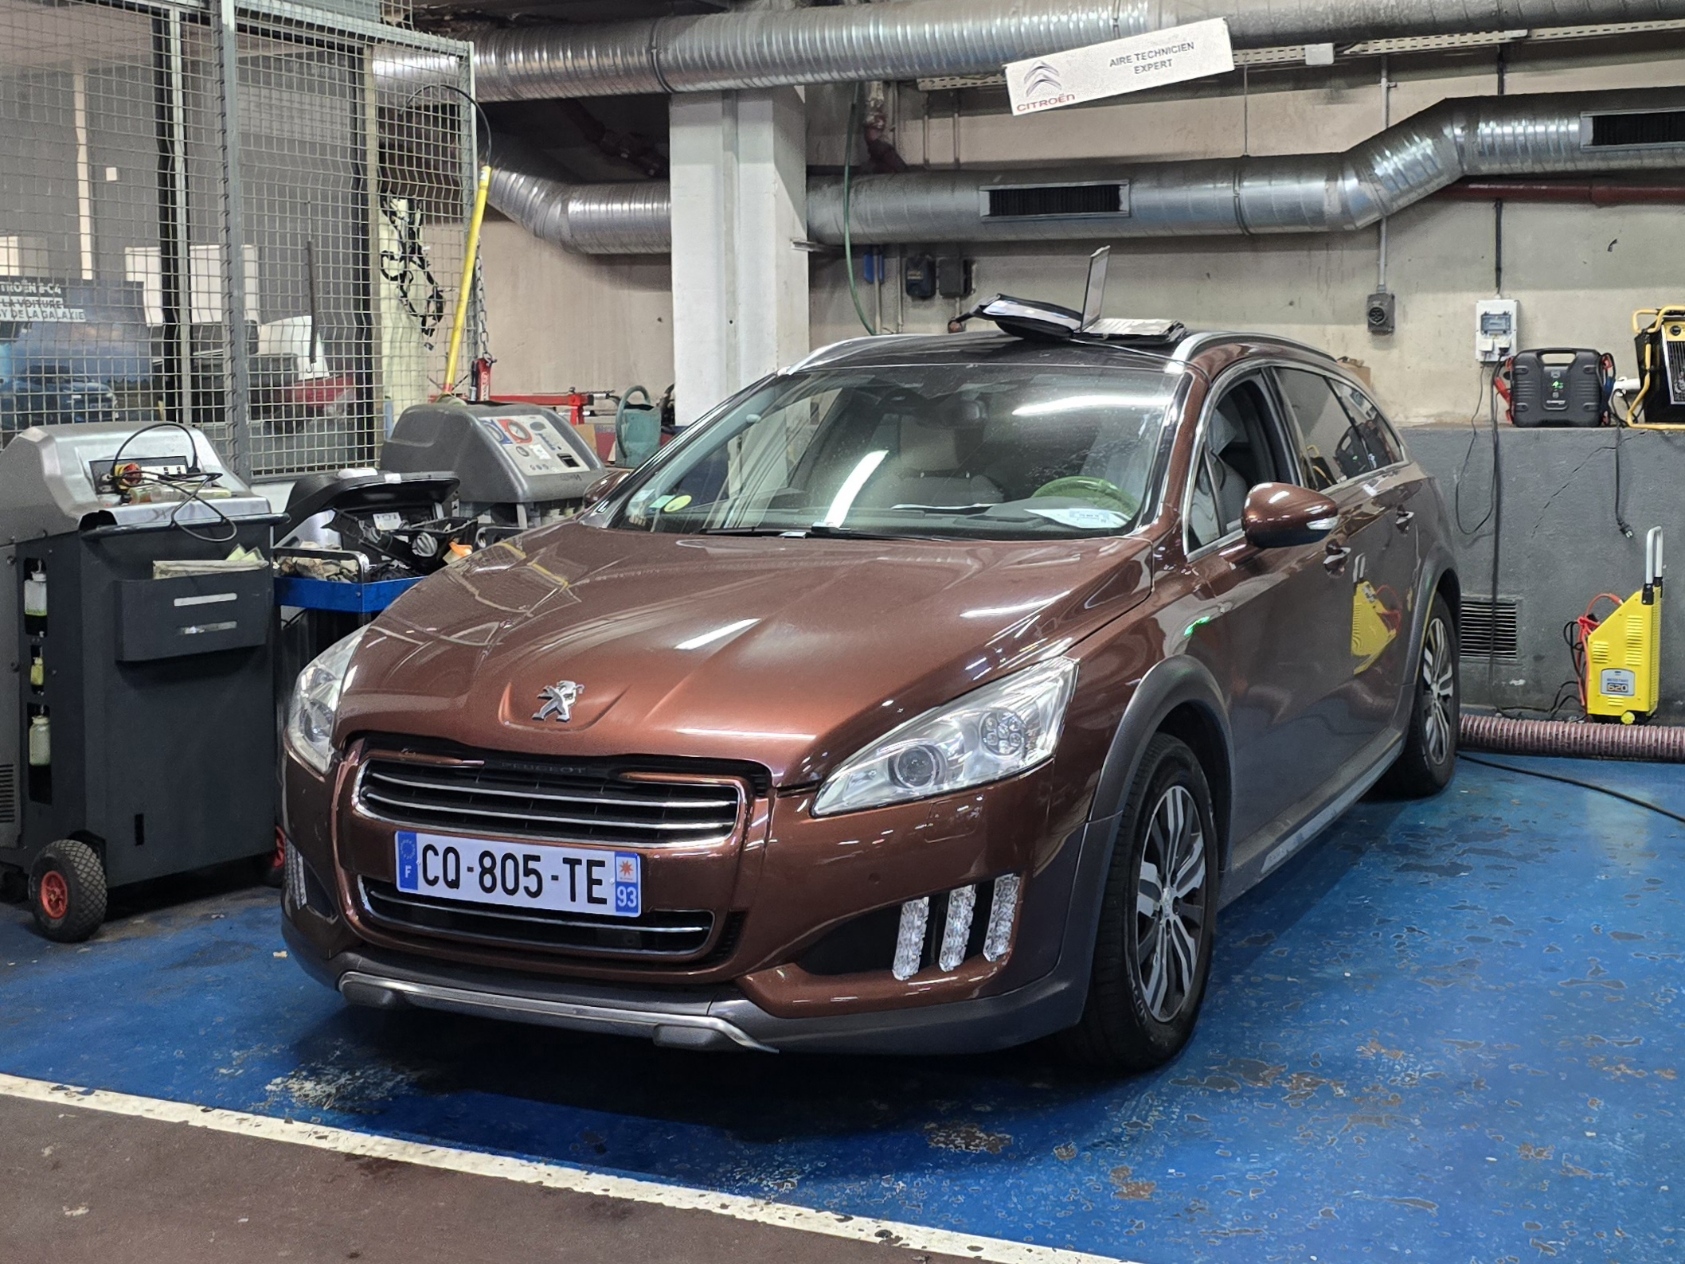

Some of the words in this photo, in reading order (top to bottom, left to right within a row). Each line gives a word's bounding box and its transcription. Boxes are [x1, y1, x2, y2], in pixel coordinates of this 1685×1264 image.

[1109, 54, 1133, 67] AIRE
[1135, 41, 1195, 62] TECHNICIEN
[1134, 58, 1173, 75] EXPERT
[501, 761, 587, 774] PEUGEOT
[404, 865, 412, 879] F
[421, 843, 608, 905] CQ-805-TE
[616, 885, 637, 908] 93
